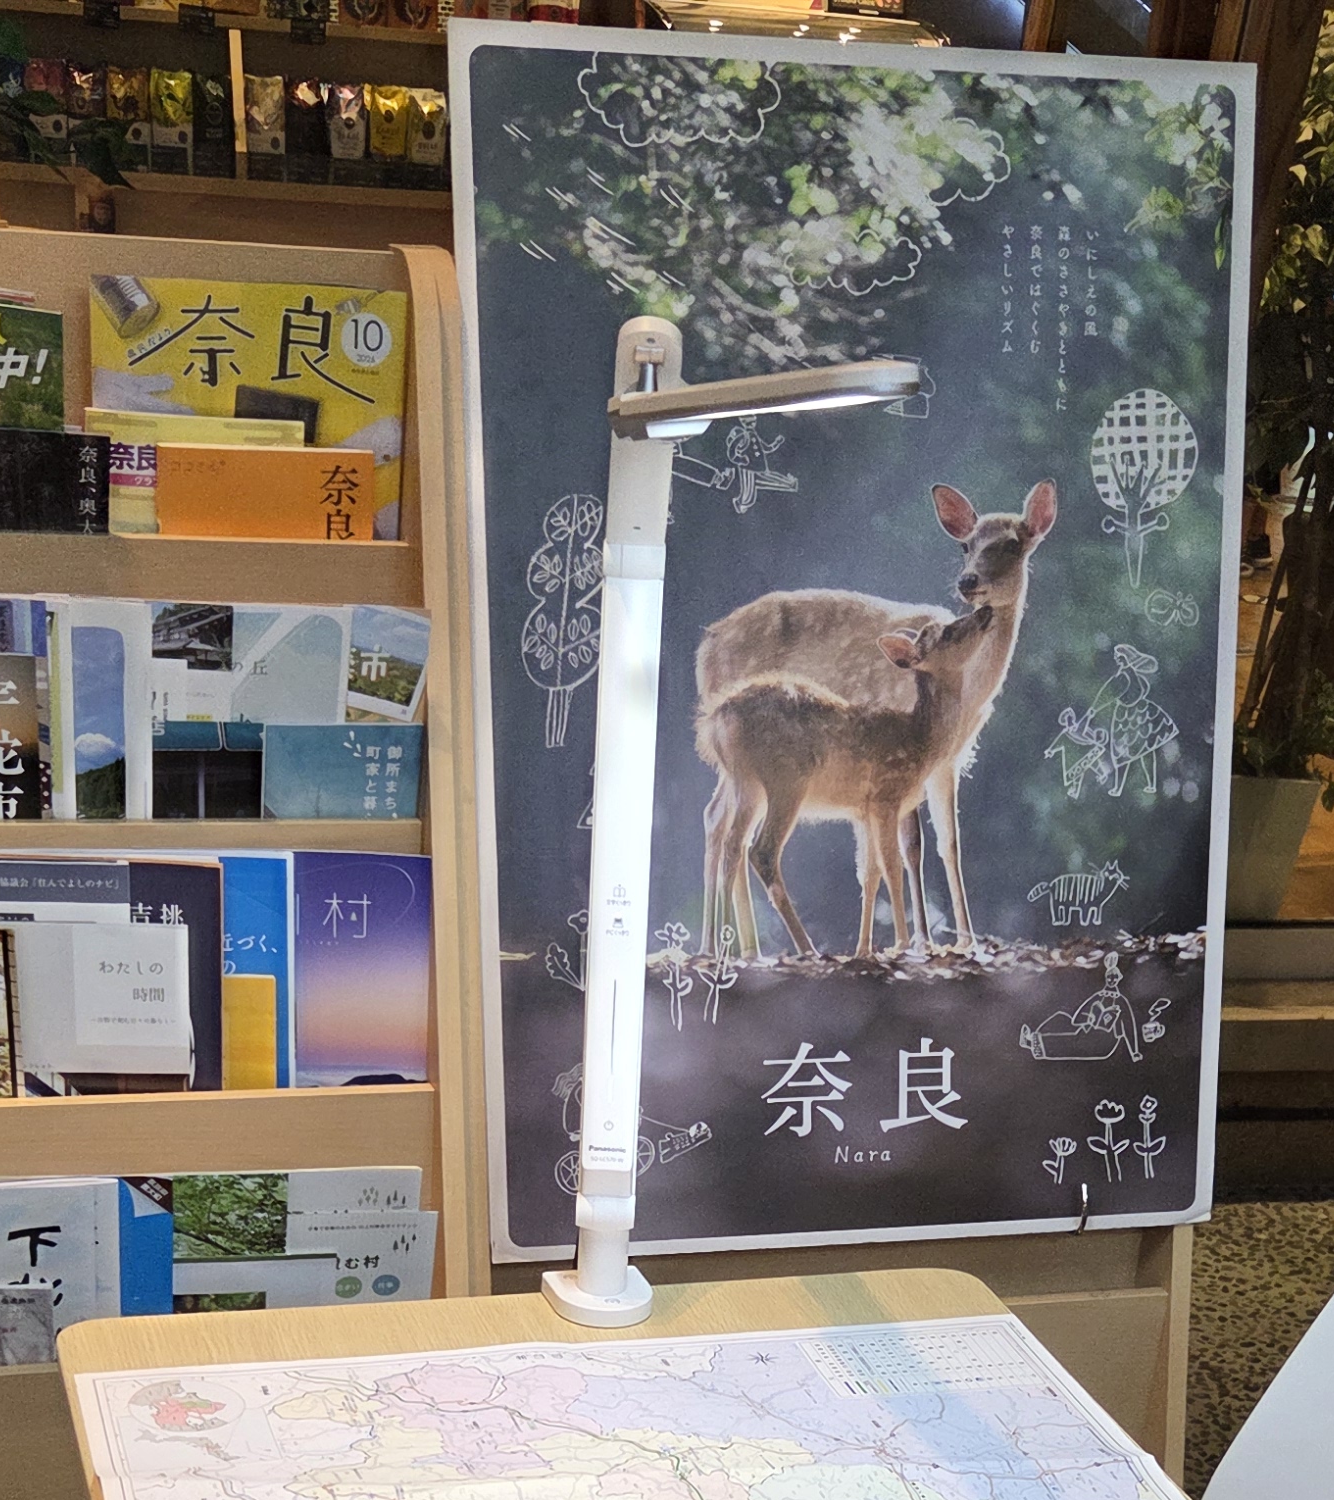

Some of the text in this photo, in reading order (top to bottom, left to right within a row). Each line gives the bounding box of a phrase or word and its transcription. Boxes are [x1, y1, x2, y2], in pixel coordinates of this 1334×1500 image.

[1001, 225, 1014, 353] やさしいリズム
[1030, 225, 1043, 354] 奈良ではぐくむ
[1084, 230, 1099, 336] いにしえの風
[351, 319, 383, 351] 10
[1056, 226, 1070, 411] 森のささやきとともに
[129, 295, 375, 403] 奈良
[109, 442, 157, 471] 奈良
[320, 465, 359, 540] 奈良
[99, 961, 164, 976] わたしの
[132, 988, 165, 1002] 時間
[760, 1038, 968, 1137] 奈良
[588, 1145, 626, 1153] Panasonic
[834, 1145, 892, 1164] Nara
[7, 1226, 61, 1267] 下
